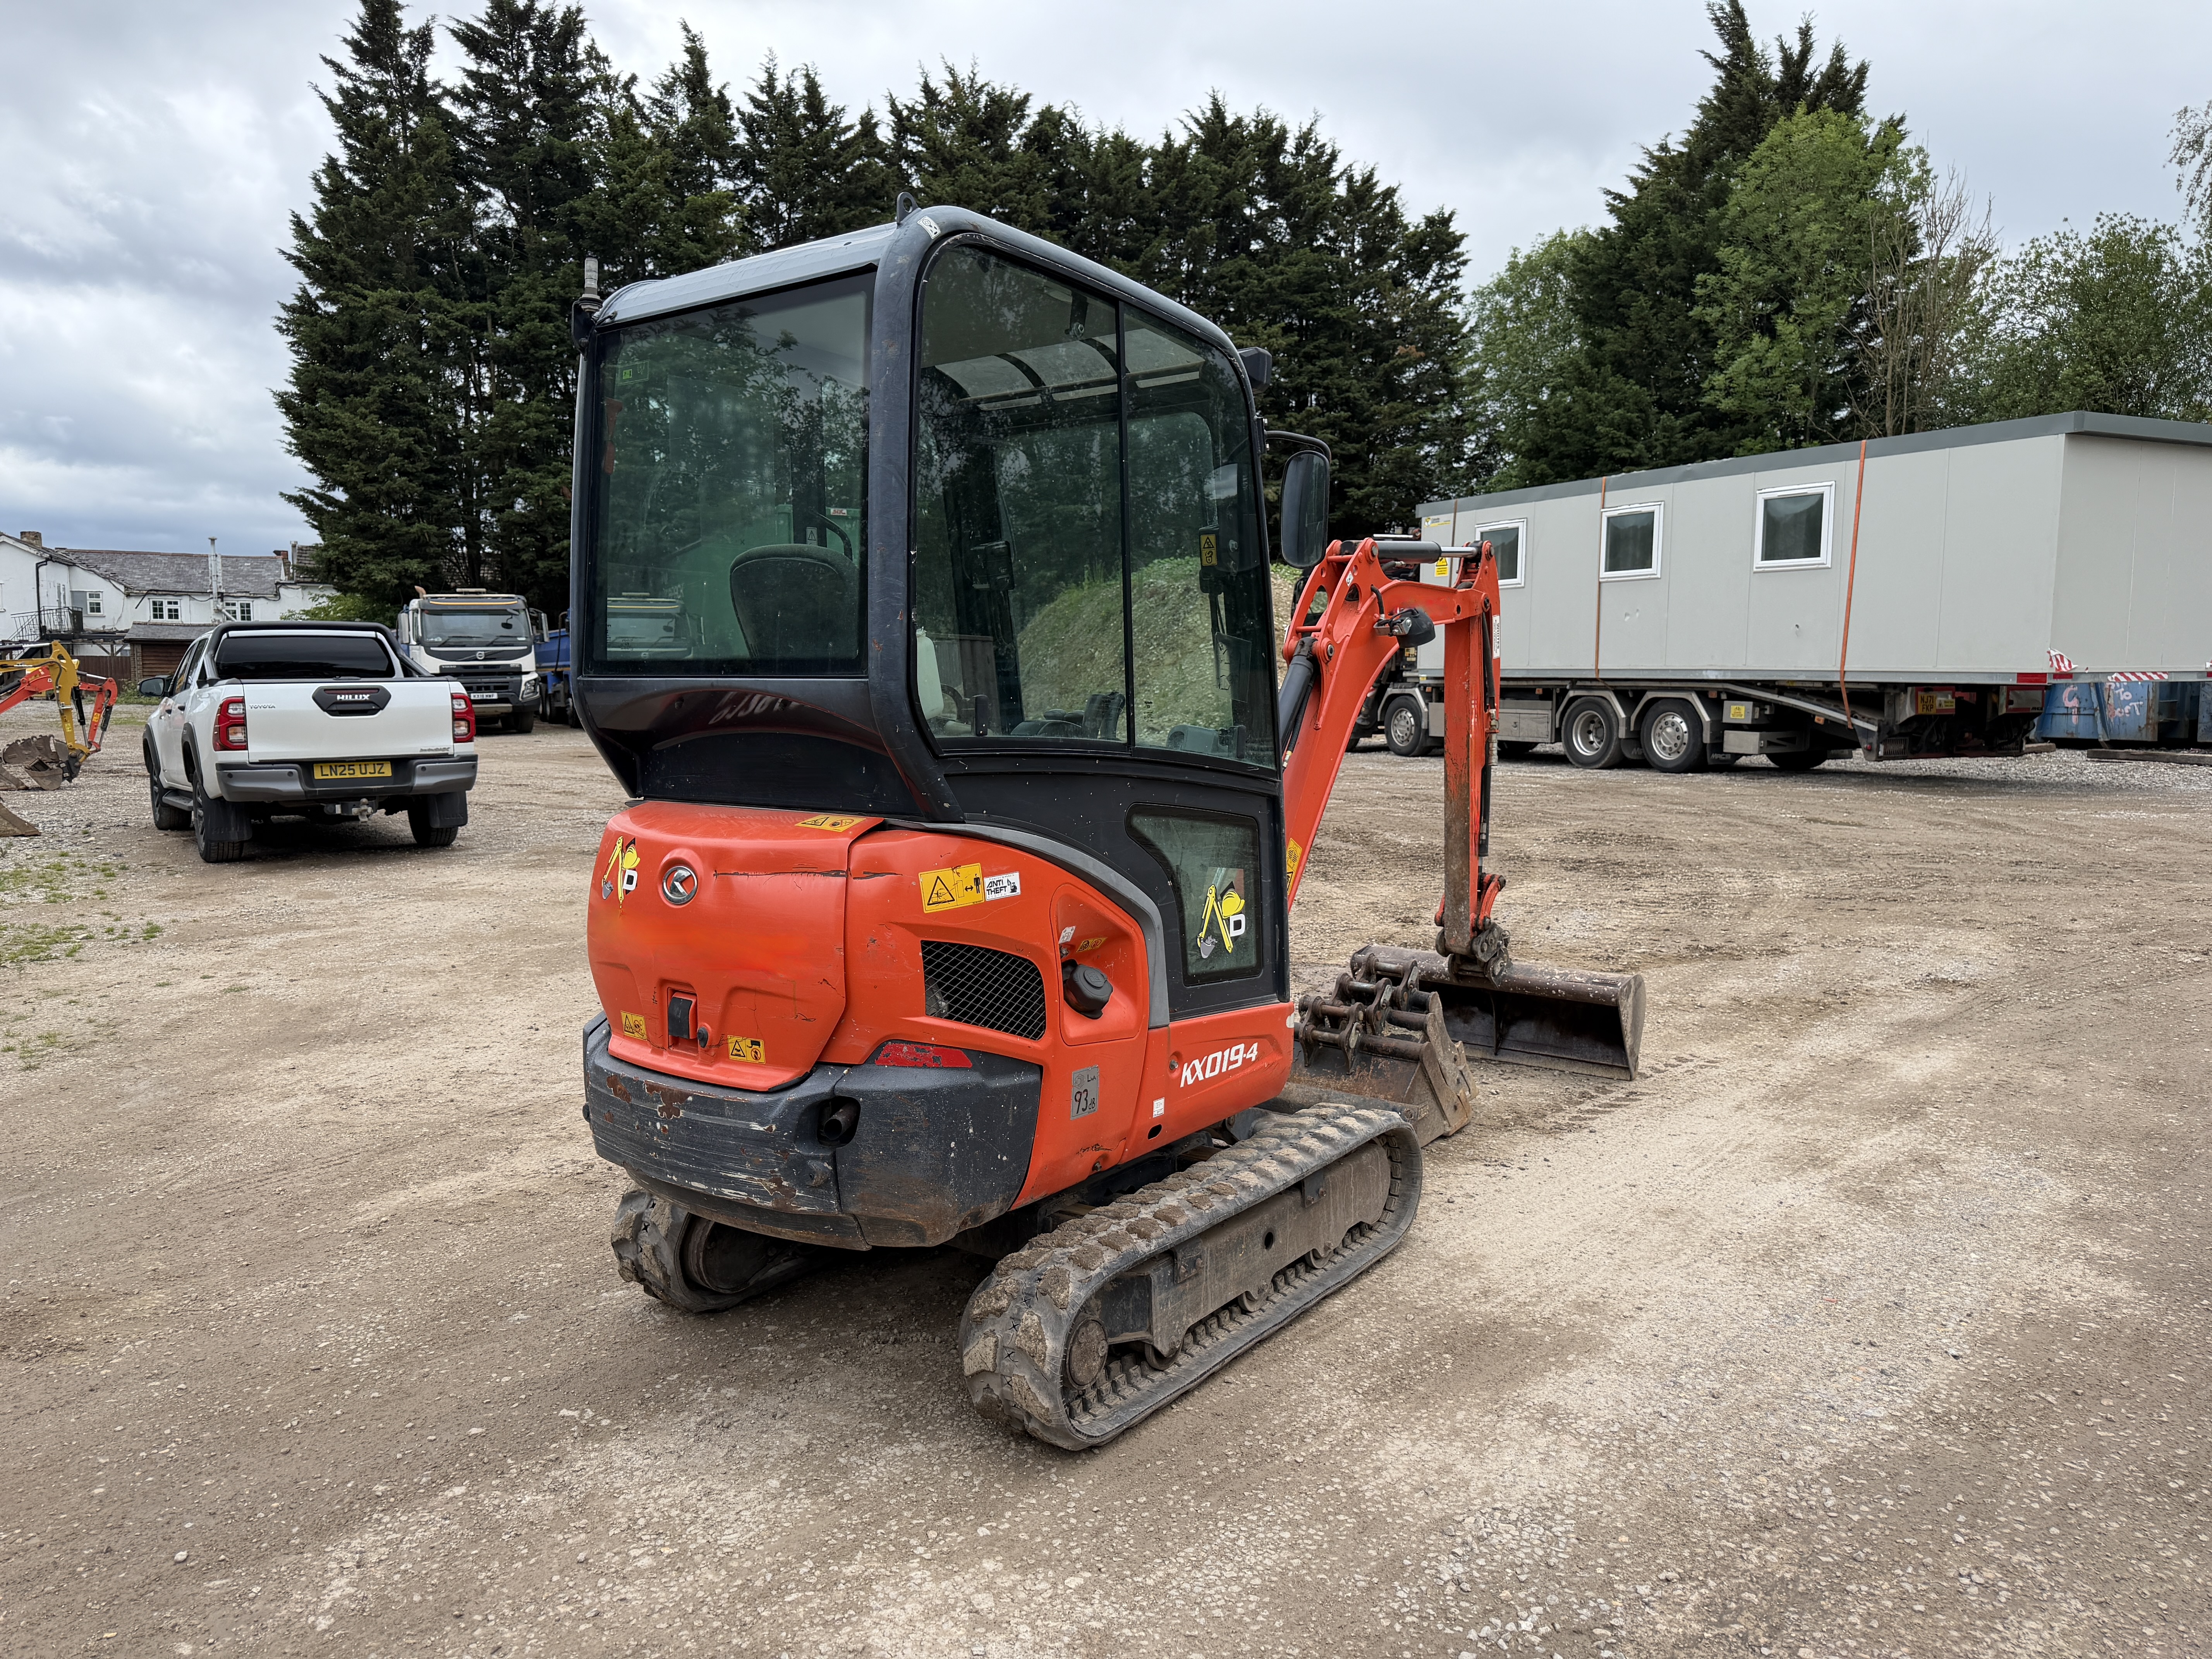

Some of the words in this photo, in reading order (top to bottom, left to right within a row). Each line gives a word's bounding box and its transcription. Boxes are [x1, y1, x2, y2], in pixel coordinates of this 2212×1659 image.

[1921, 696, 1934, 704] NJ71
[320, 764, 356, 776] LN25
[359, 763, 385, 775] UJZ
[987, 879, 1004, 888] ANTI
[986, 886, 1007, 895] THEFT
